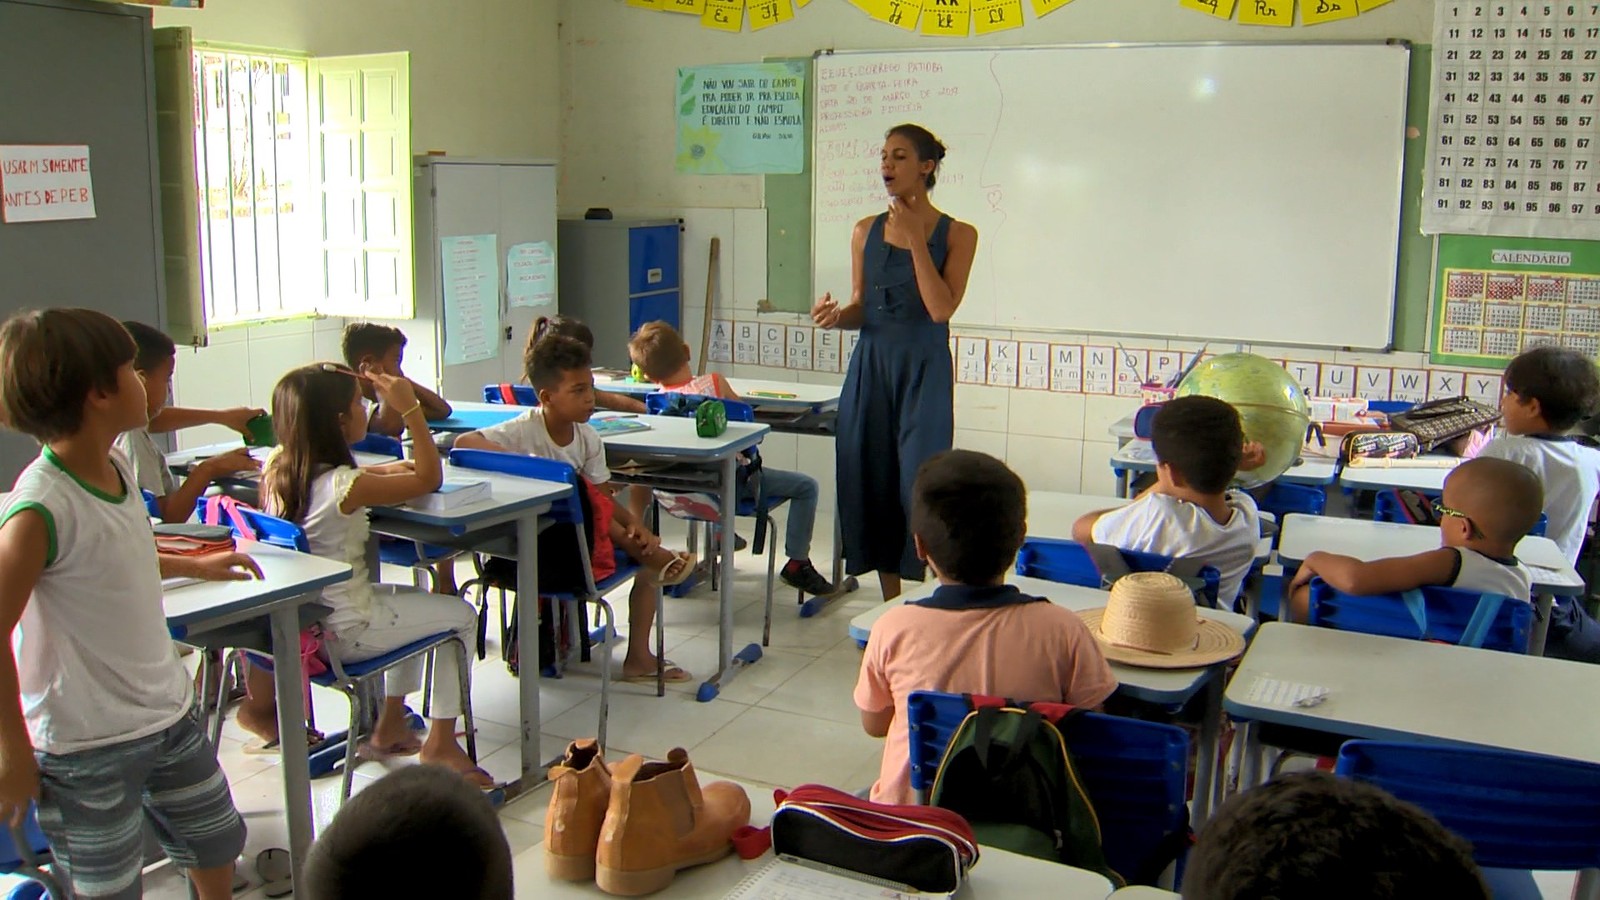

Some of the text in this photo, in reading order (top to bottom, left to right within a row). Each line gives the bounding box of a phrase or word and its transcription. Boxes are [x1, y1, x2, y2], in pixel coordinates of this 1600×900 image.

[1452, 5, 1599, 17] 1 2 3 4 5 6 7
[1449, 27, 1600, 39] 11 12 13 14 15 16 17
[1446, 49, 1598, 61] 21 22 23 24 25 26 27
[1445, 71, 1596, 83] 31 32 33 34 35 36 37
[1444, 92, 1594, 105] 41 42 43 44 45 46 47
[1443, 113, 1592, 127] 51 52 53 54 55 56 57
[1441, 135, 1590, 149] 61 62 63 64 65 66 67
[1440, 156, 1588, 171] 71 72 73 74 75 76 77
[1438, 177, 1586, 192] 81 82 83 84 85 86 87
[1437, 198, 1449, 209] 91
[1459, 199, 1472, 210] 92
[1481, 200, 1493, 210] 93
[1503, 200, 1516, 211] 94
[1525, 202, 1538, 212] 95
[1548, 202, 1561, 213] 96
[1571, 203, 1584, 214] 97
[1492, 252, 1570, 265] CALENDÁRIO
[716, 324, 725, 337] A
[742, 326, 750, 338] B
[768, 328, 777, 341] C
[795, 331, 804, 343] D
[822, 333, 831, 345] E
[967, 343, 1169, 369] J K L M N O P
[1296, 367, 1489, 394] T U V W X Y
